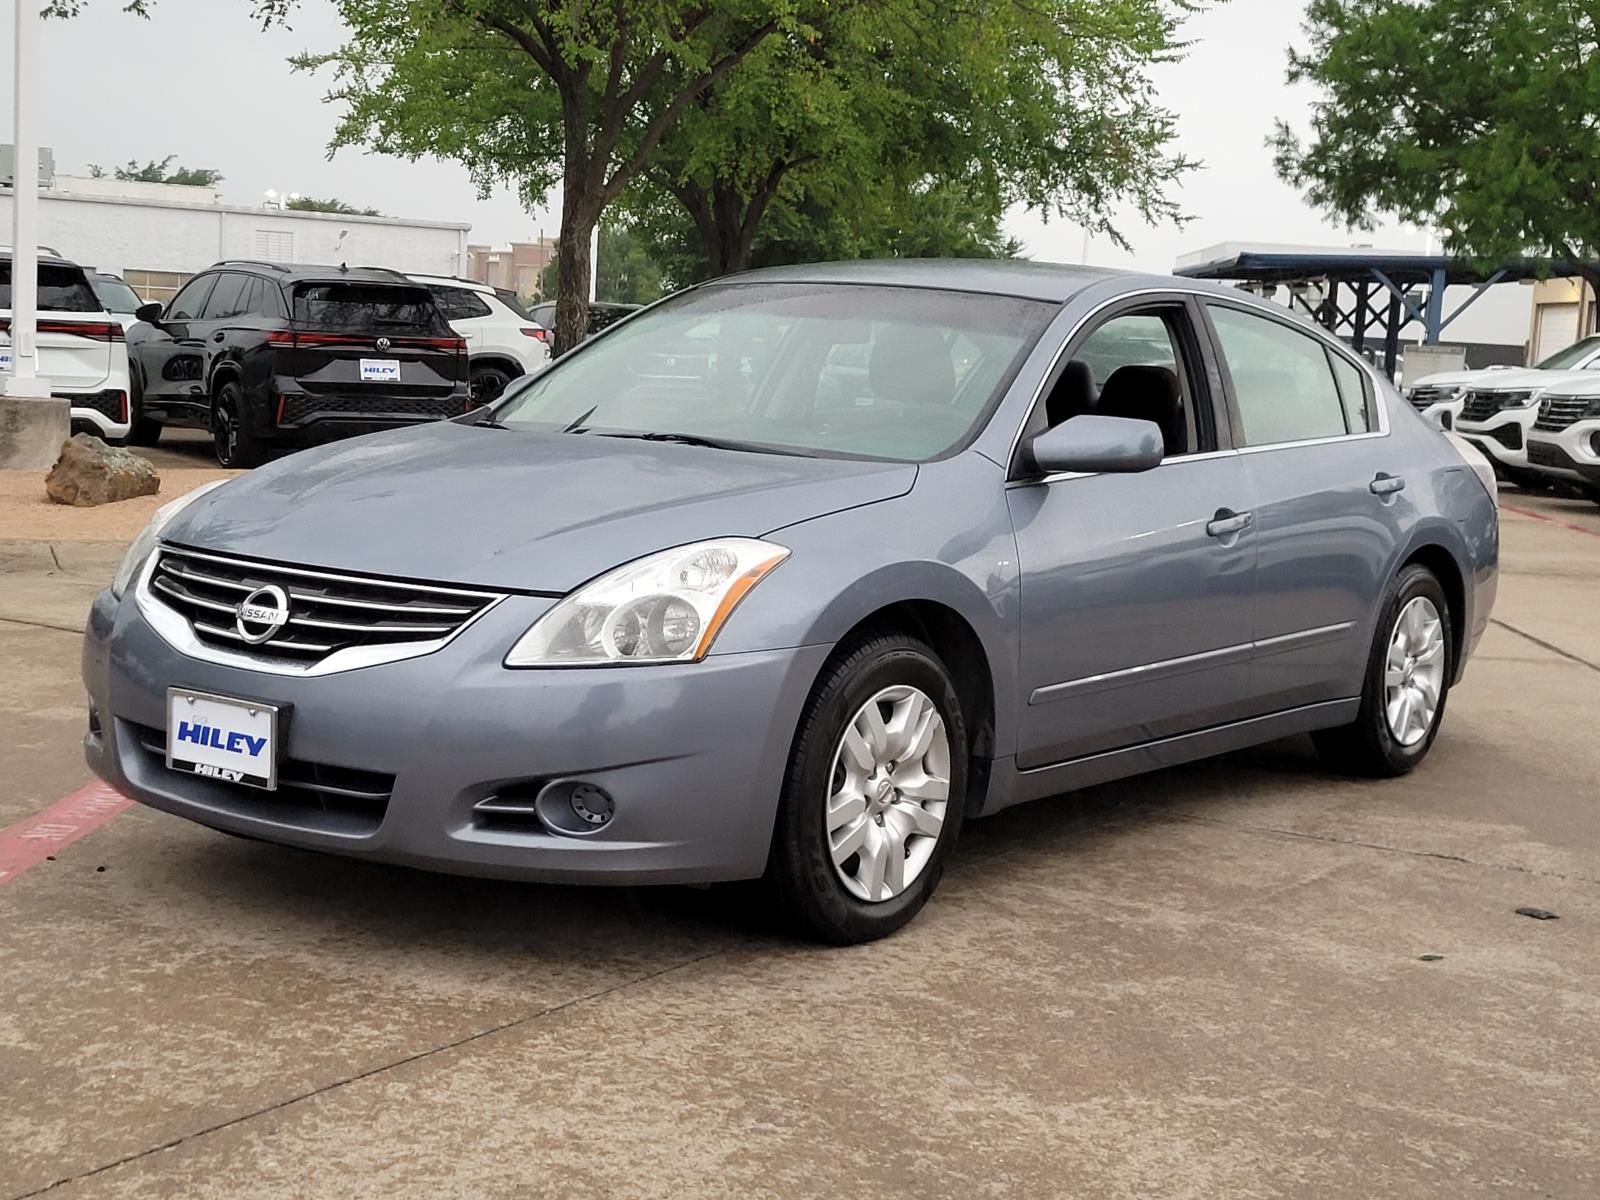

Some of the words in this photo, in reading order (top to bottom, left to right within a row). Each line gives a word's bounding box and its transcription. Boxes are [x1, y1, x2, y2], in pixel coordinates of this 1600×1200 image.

[242, 606, 279, 621] NISSAN
[178, 721, 268, 757] HILEY
[194, 763, 245, 782] HILEY
